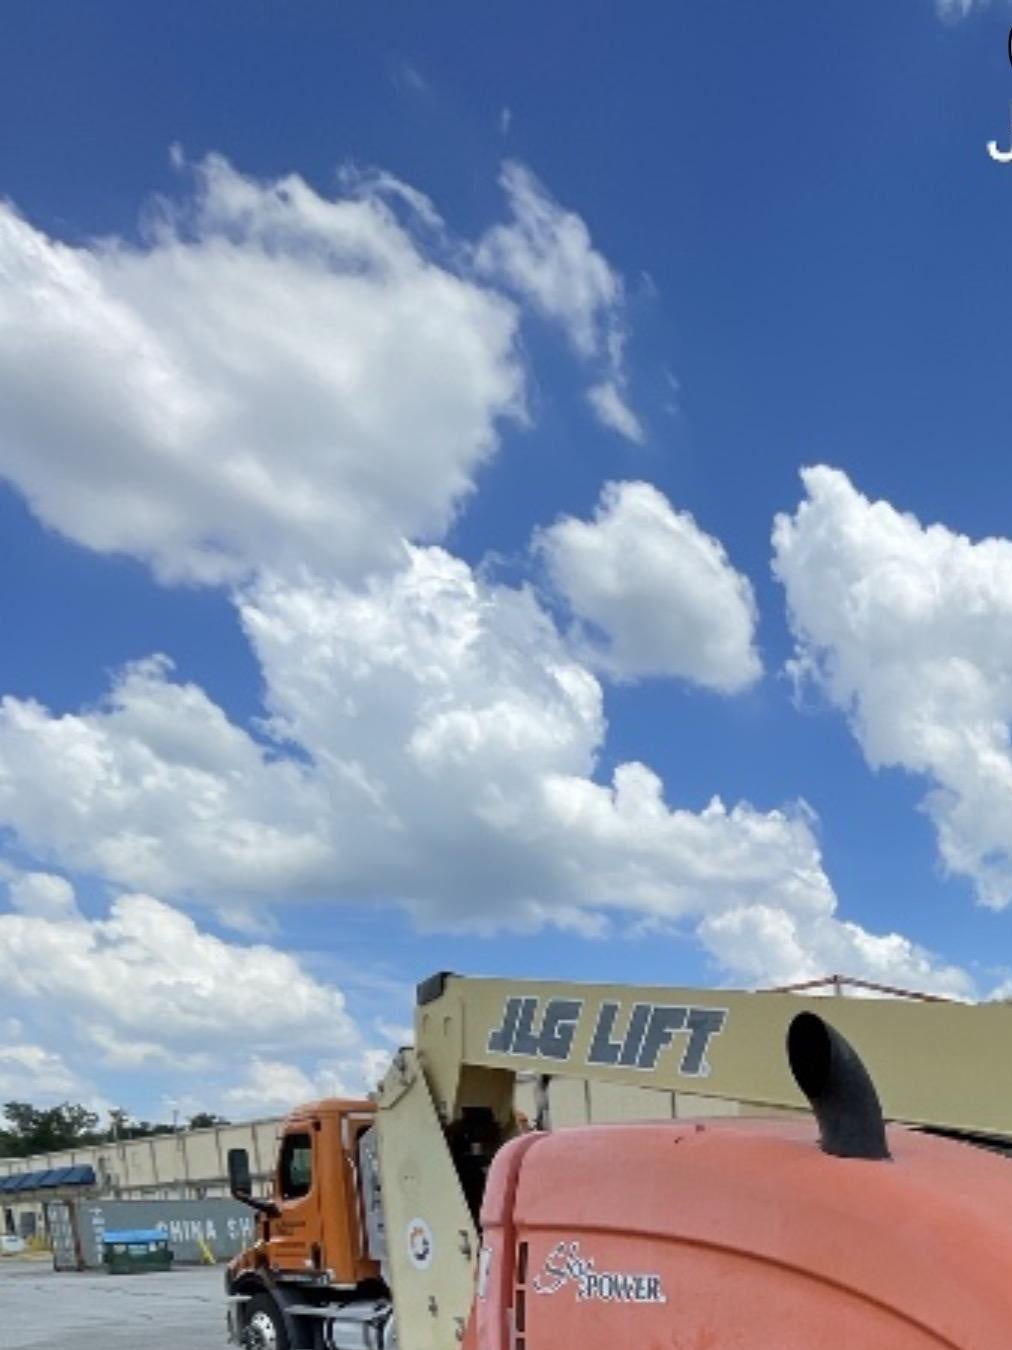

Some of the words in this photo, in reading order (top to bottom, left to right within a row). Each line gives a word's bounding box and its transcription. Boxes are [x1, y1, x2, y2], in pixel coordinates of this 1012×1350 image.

[486, 996, 585, 1062] JLG
[585, 1002, 729, 1077] LIFT
[584, 1273, 662, 1302] POWER
